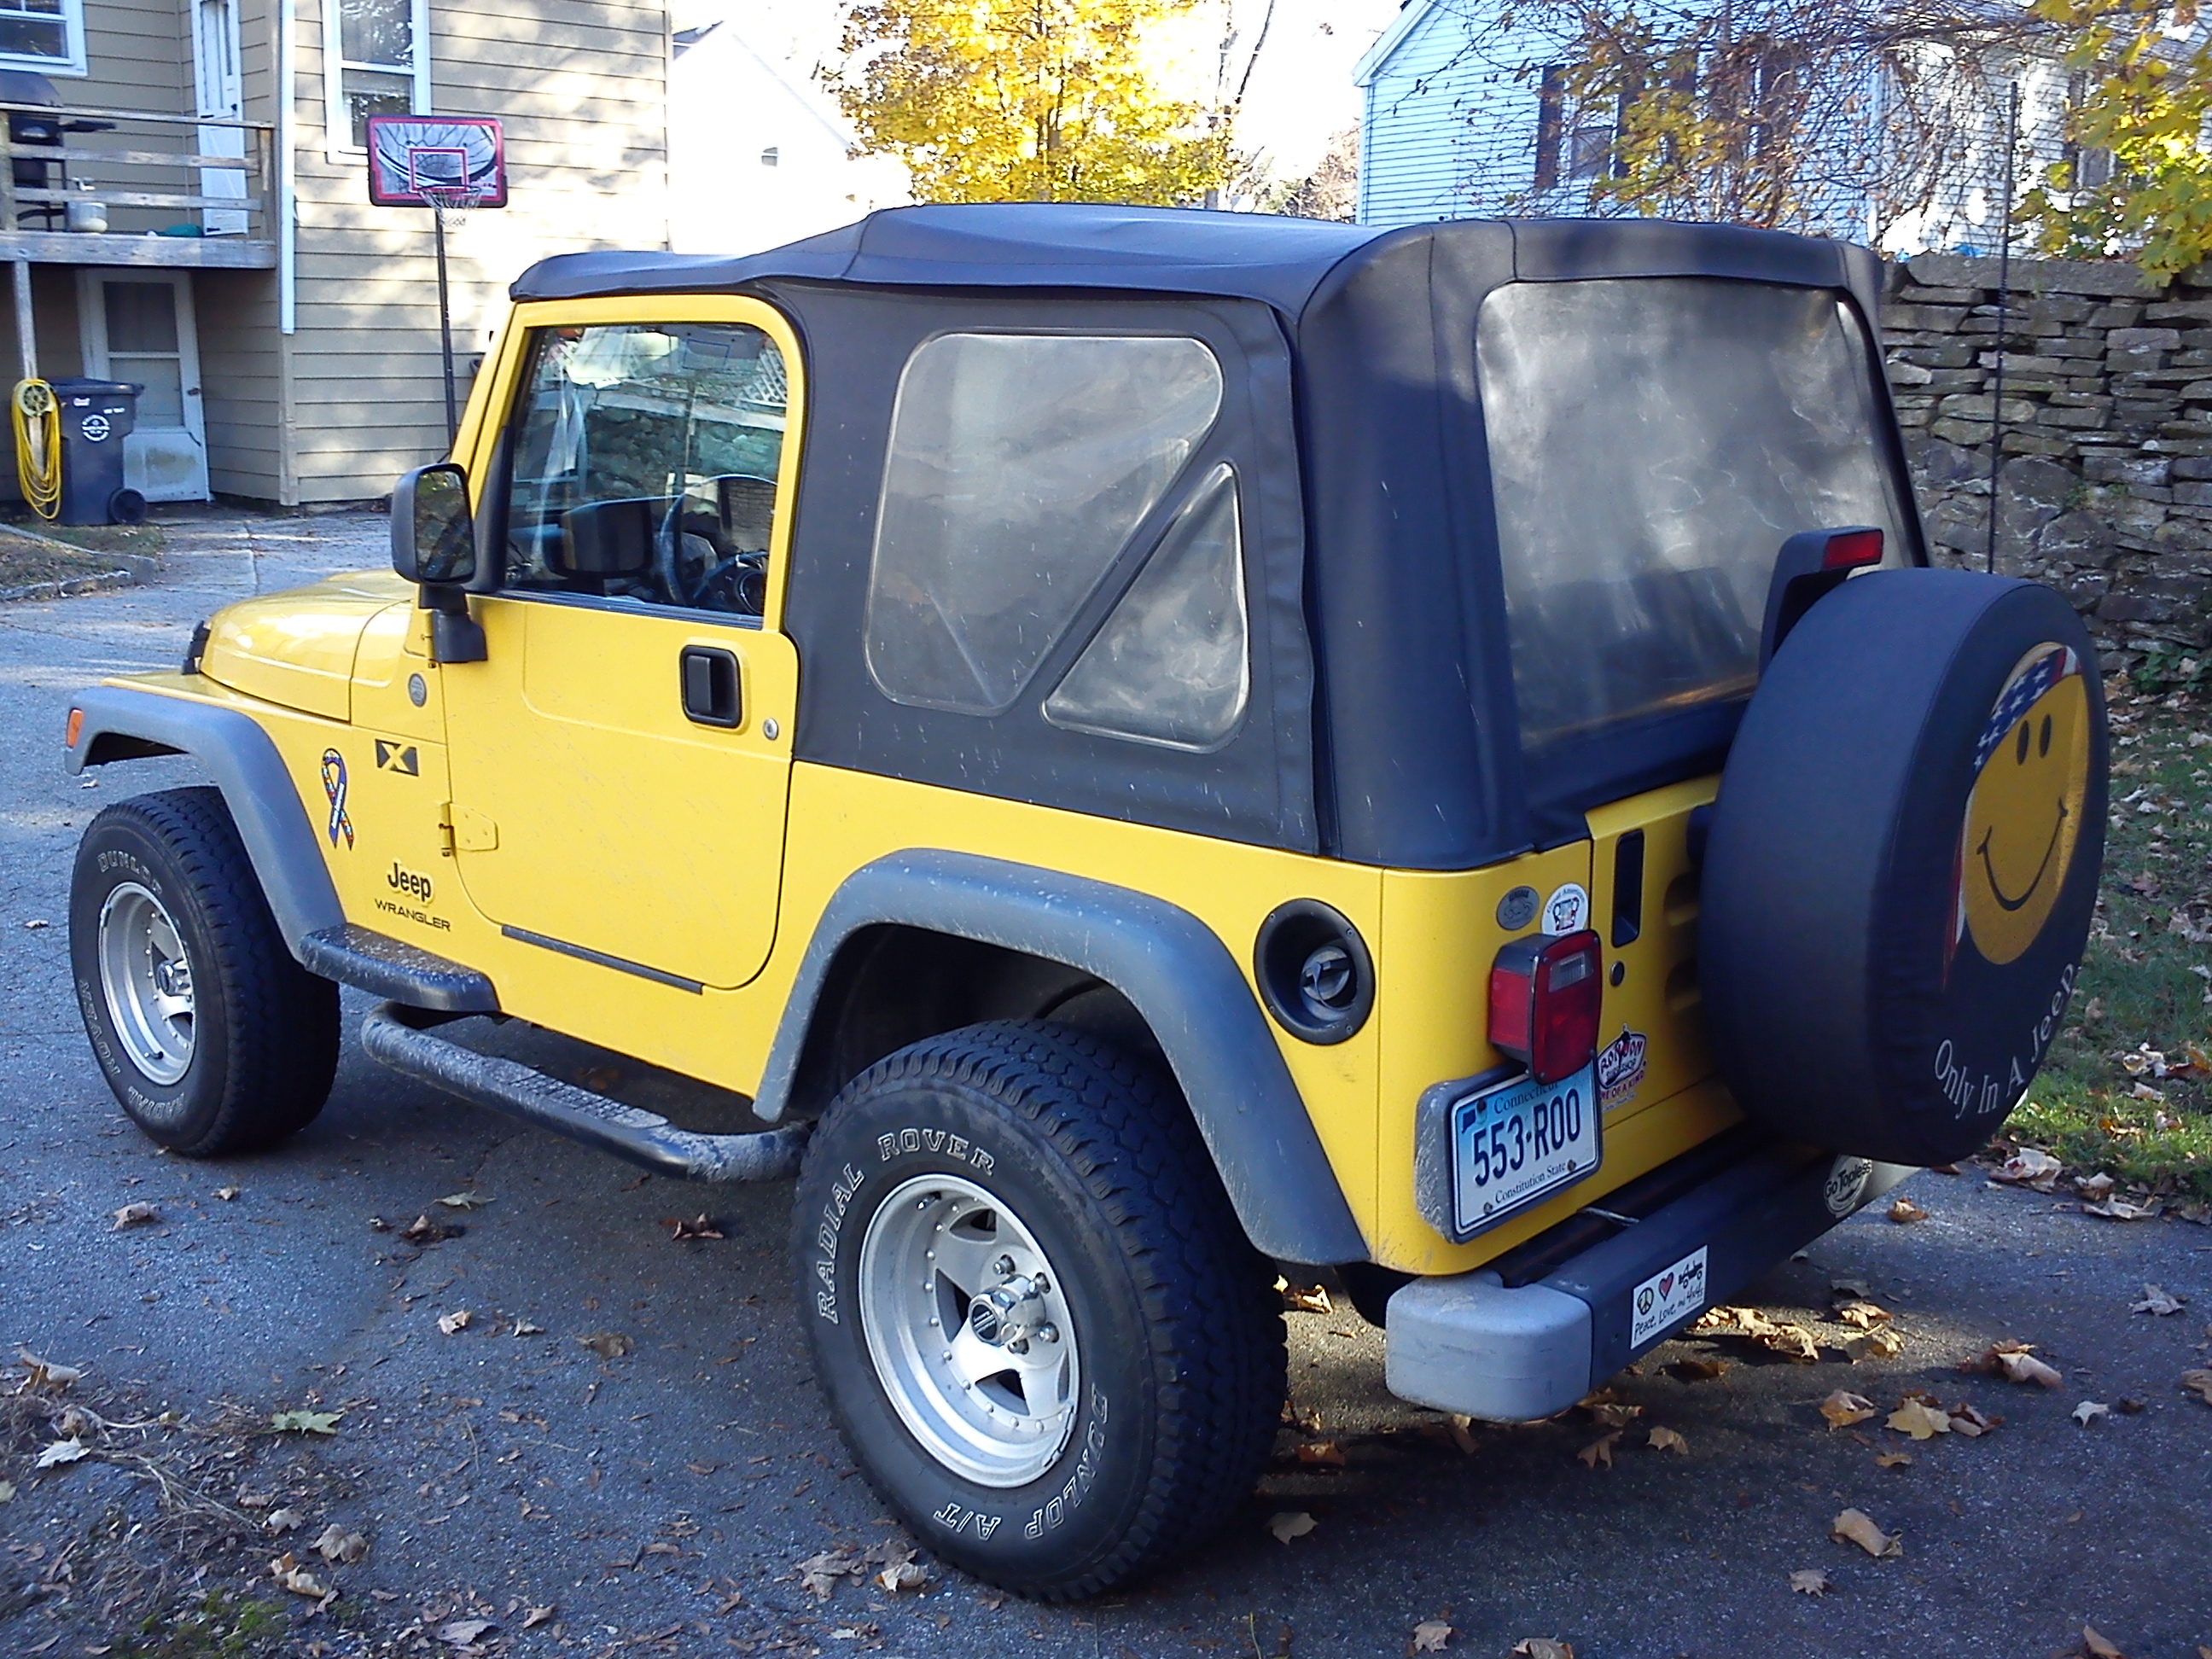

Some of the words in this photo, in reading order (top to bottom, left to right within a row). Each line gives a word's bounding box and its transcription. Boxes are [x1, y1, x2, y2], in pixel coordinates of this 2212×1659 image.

[97, 851, 162, 895] DUNLOP
[387, 862, 432, 902] Jeep
[375, 899, 451, 932] WRANGLER
[1935, 1039, 1975, 1120] Only
[1978, 1074, 1999, 1114] In
[2006, 1056, 2025, 1098] A
[2030, 963, 2075, 1063] Jeep
[1495, 1172, 1545, 1204] Constitution
[1547, 1161, 1567, 1178] State
[1826, 1181, 1837, 1198] Go
[1838, 1161, 1871, 1192] Topless
[817, 1163, 864, 1324] RADIAL
[878, 1128, 995, 1176] ROVER
[1024, 1382, 1108, 1540] DUNLOP
[933, 1503, 1002, 1541] A/T
